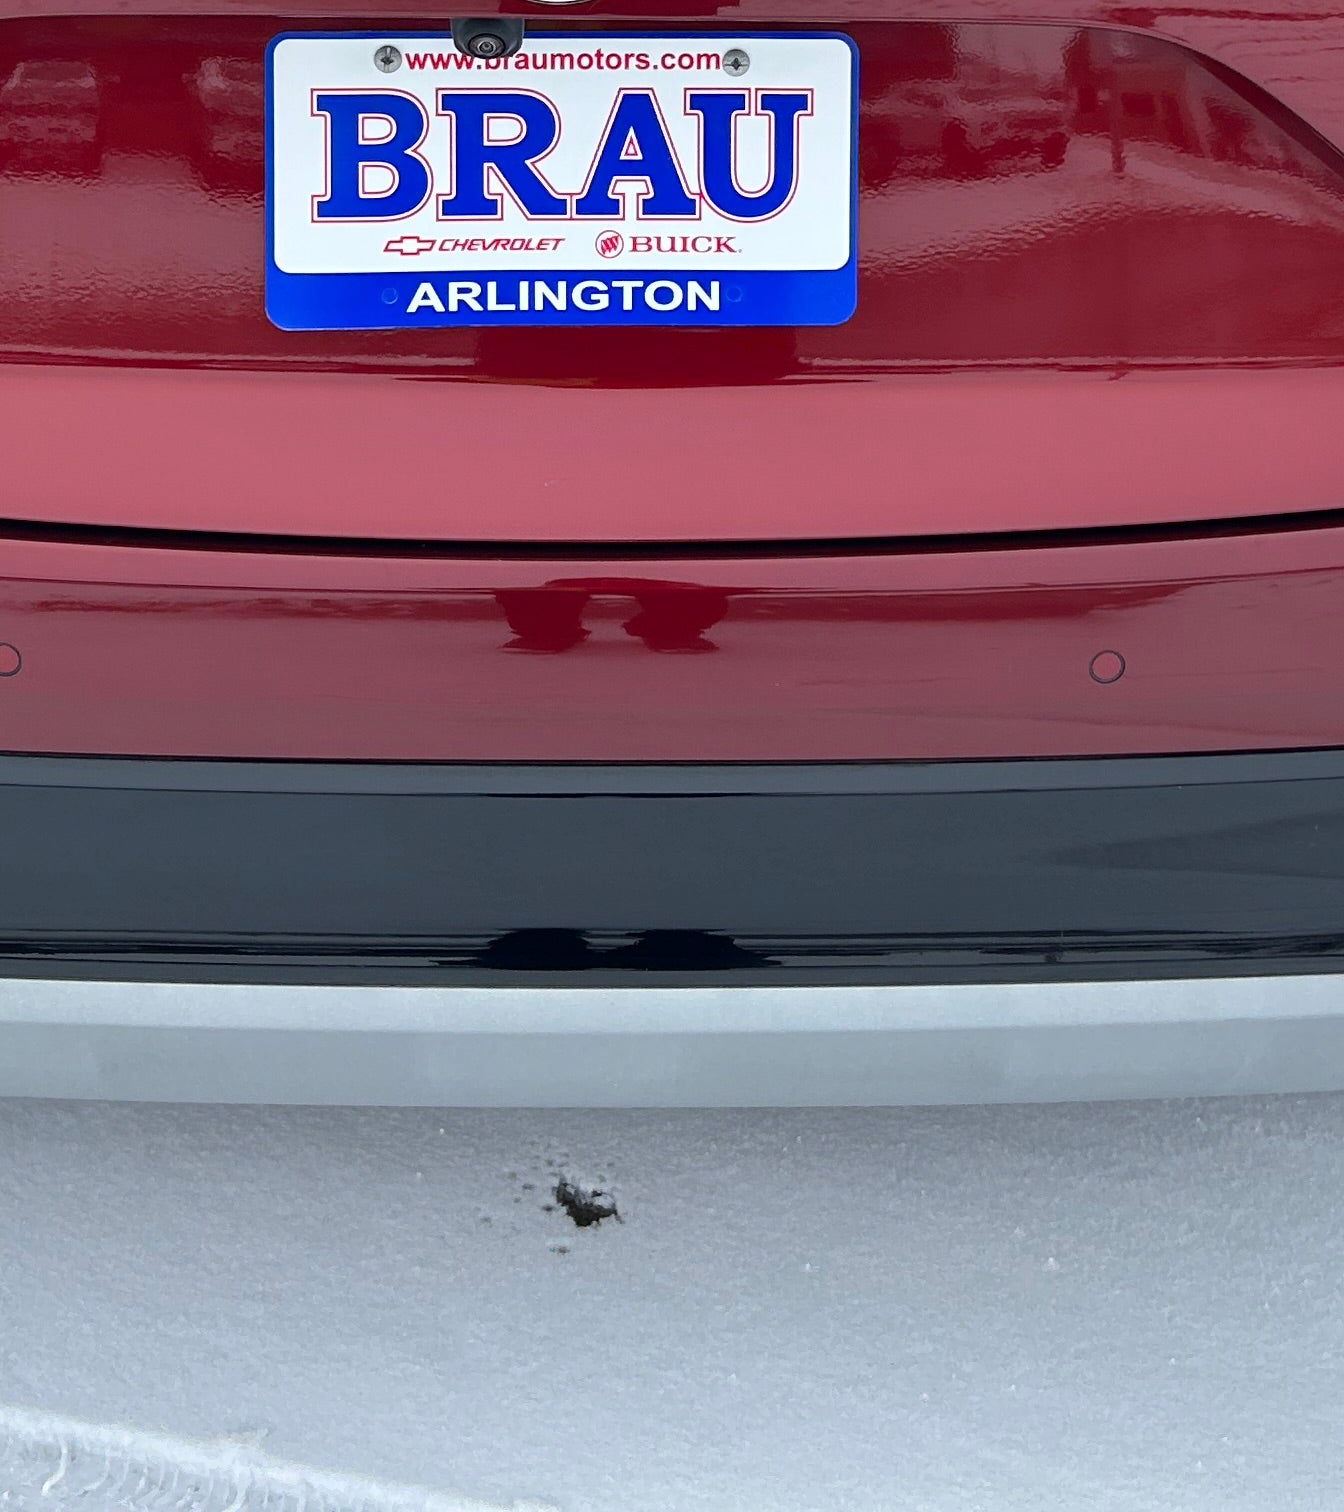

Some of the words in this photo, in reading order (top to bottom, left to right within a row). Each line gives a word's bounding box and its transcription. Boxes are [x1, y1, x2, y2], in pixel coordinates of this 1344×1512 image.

[310, 88, 814, 223] BRAU
[438, 237, 566, 252] CHEVROLET
[628, 235, 737, 254] BUICK
[406, 279, 721, 314] ARLINGTON
